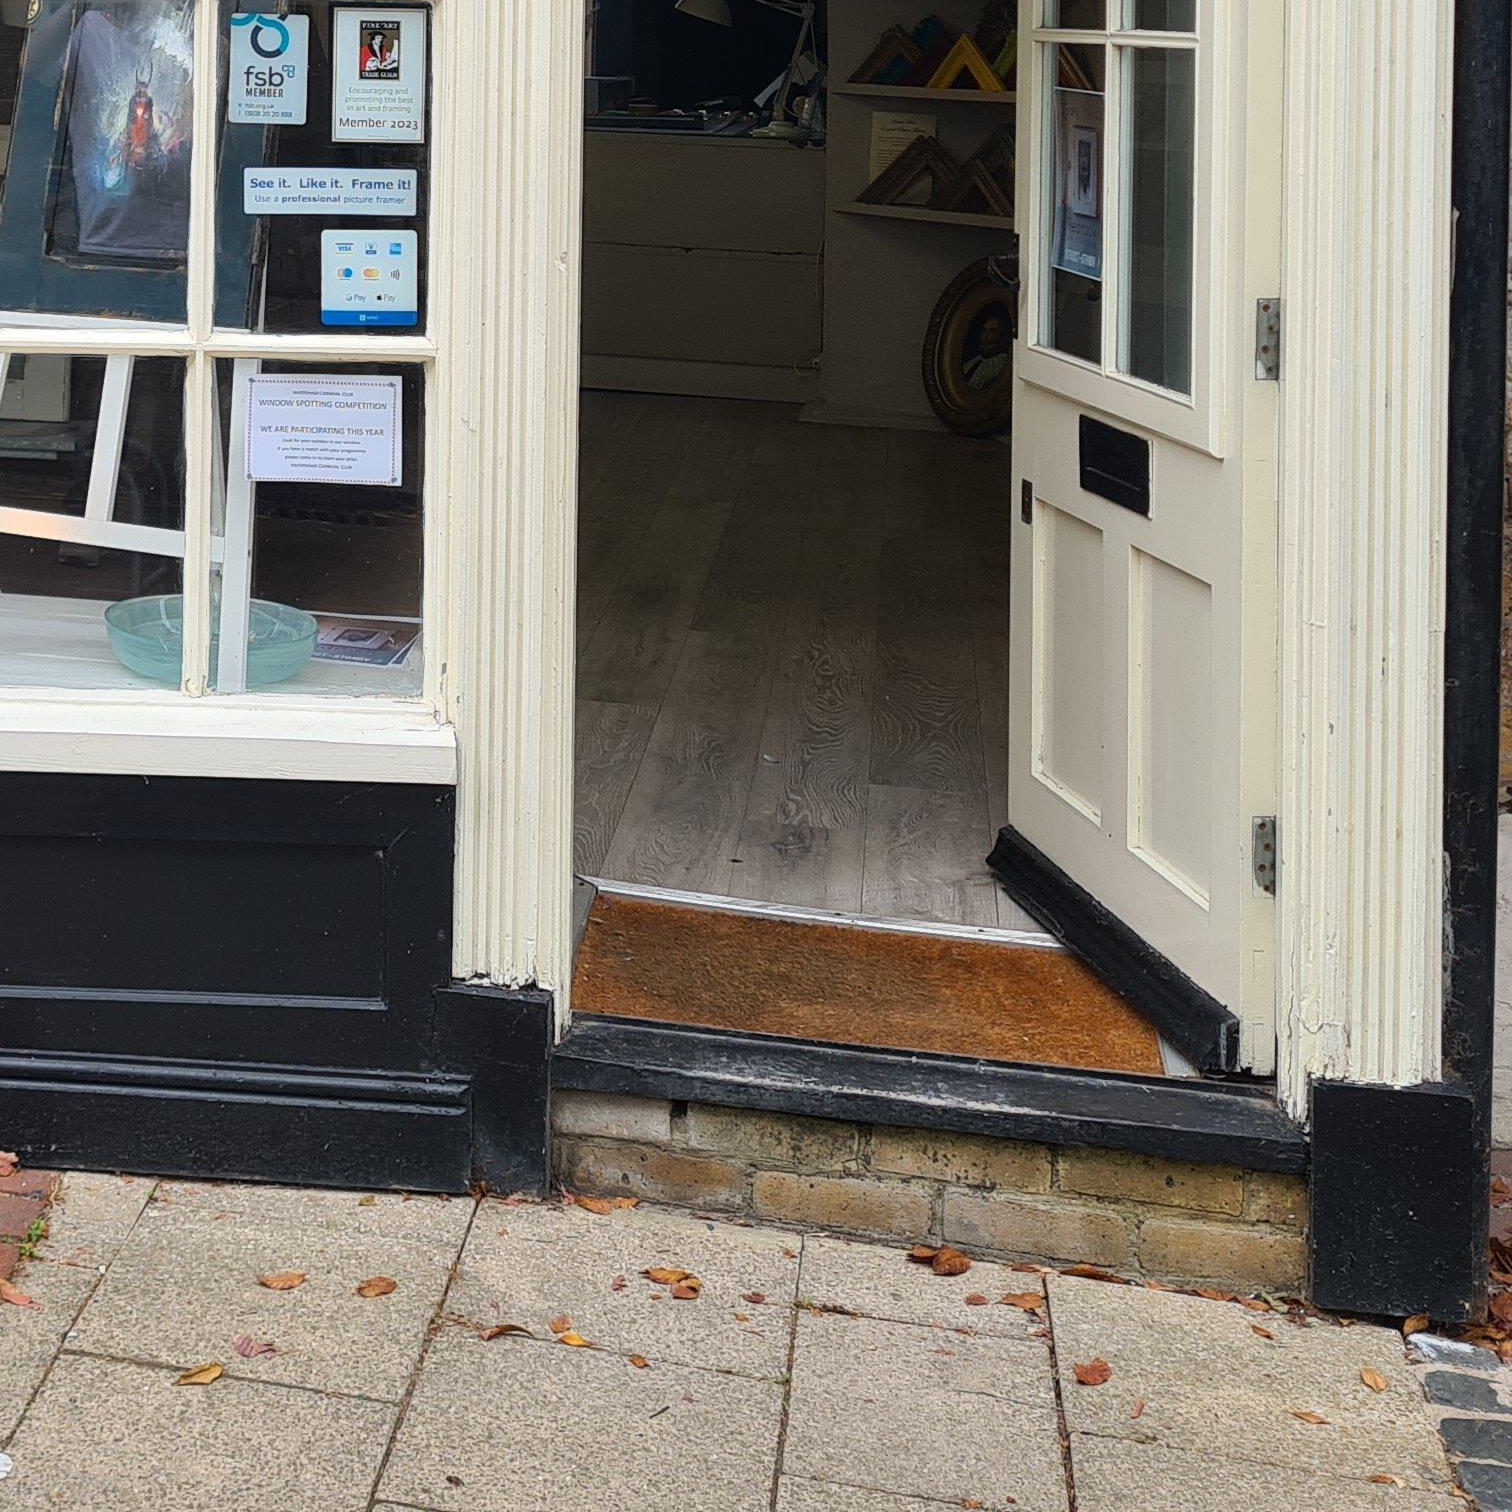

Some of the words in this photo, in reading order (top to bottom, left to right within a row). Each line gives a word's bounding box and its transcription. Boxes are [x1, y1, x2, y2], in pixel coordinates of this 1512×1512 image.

[243, 65, 285, 87] fsb
[245, 88, 284, 97] MEMBER
[348, 86, 393, 96] Encouraging
[344, 96, 383, 105] promoting
[382, 105, 411, 114] framing
[339, 117, 388, 129] Member
[390, 119, 419, 131] 2023
[250, 177, 274, 189] See
[278, 177, 291, 189] it.
[299, 178, 327, 189] Like
[330, 178, 344, 189] it.
[351, 178, 394, 190] Frame
[397, 179, 411, 190] it!
[254, 194, 271, 203] Use
[281, 194, 341, 205] professional
[343, 194, 374, 206] picture
[375, 195, 406, 205] framer
[353, 293, 367, 303] Pay
[383, 293, 396, 303] Pay
[258, 399, 294, 407] WINDOW
[295, 399, 333, 409] SPOTTING
[334, 401, 387, 410] COMPETITION
[260, 425, 273, 433] WE
[274, 425, 289, 433] ARE
[290, 426, 345, 435] PARTICIPATING
[347, 428, 364, 436] THIS
[365, 428, 385, 436] YEAR
